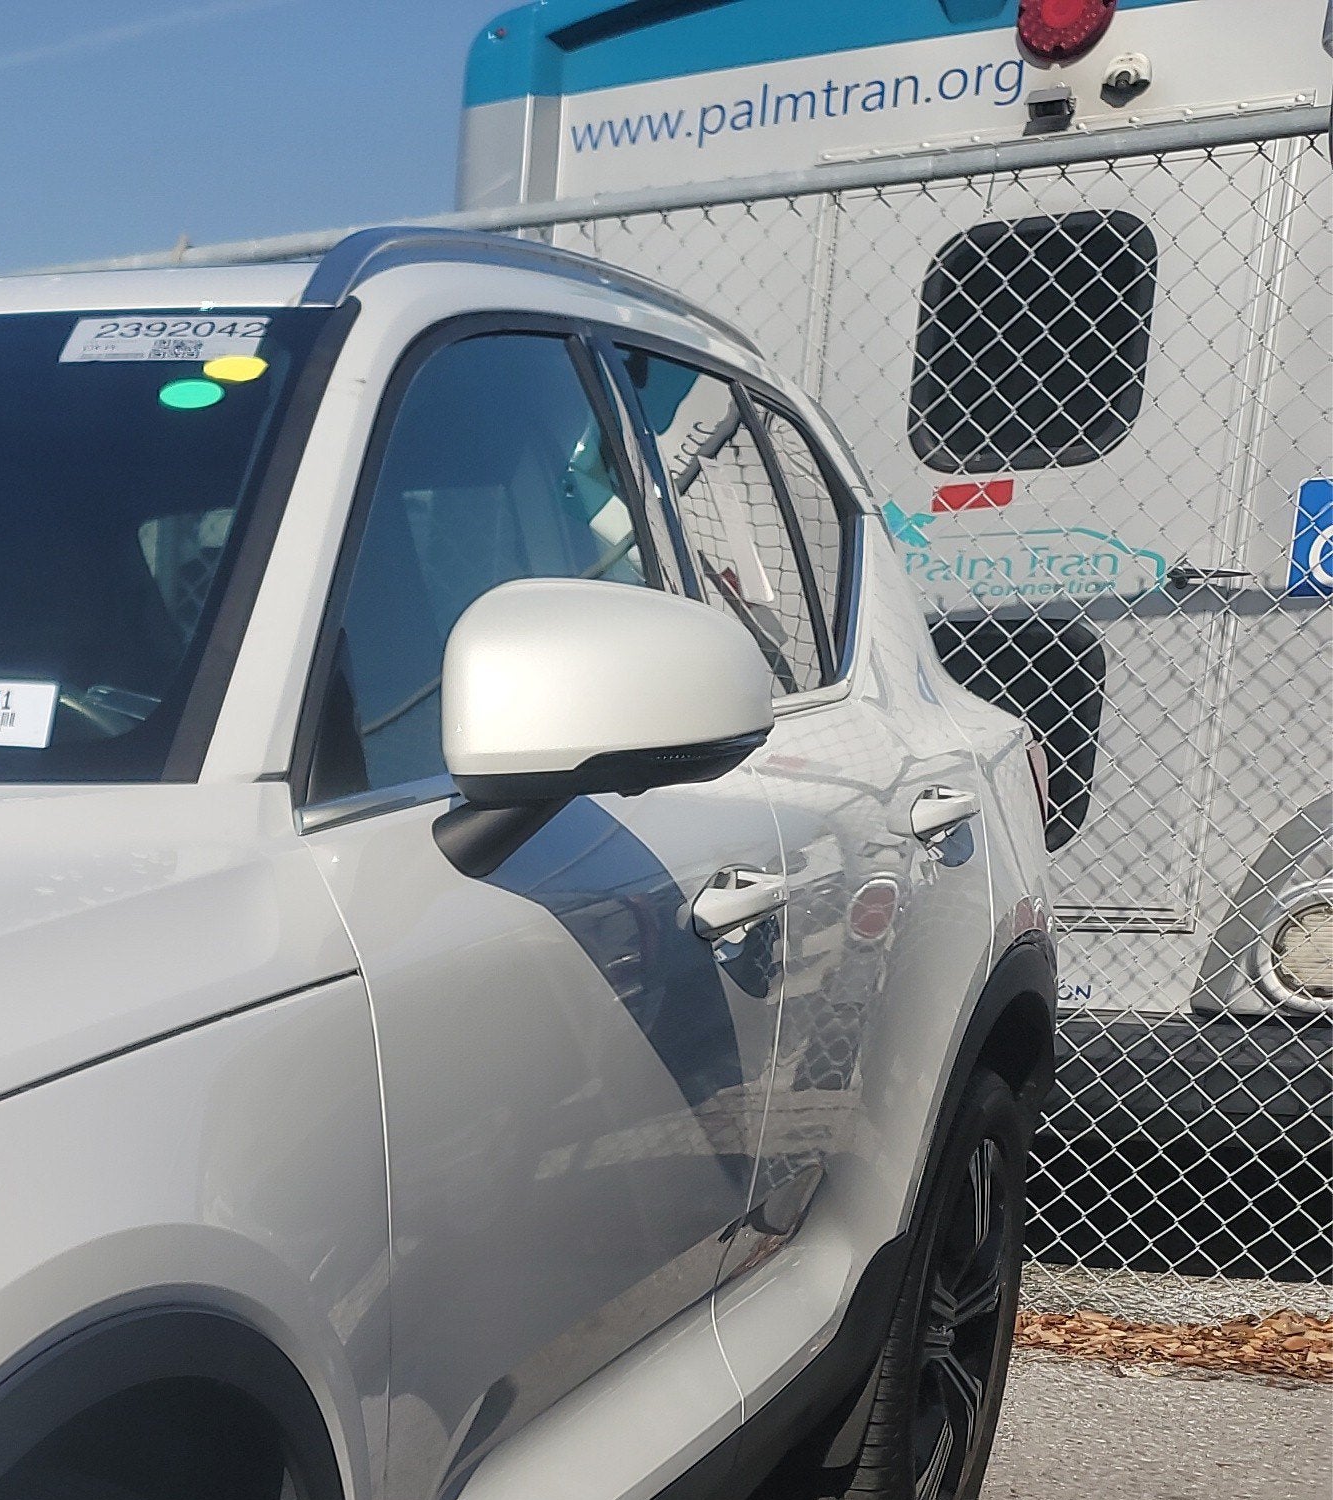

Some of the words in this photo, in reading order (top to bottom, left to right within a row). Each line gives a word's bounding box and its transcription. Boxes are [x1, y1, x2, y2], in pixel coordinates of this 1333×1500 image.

[570, 58, 1025, 153] www.palmtran.org
[94, 321, 268, 339] 2392042
[904, 550, 1013, 582] Palm
[1018, 546, 1119, 578] Tran
